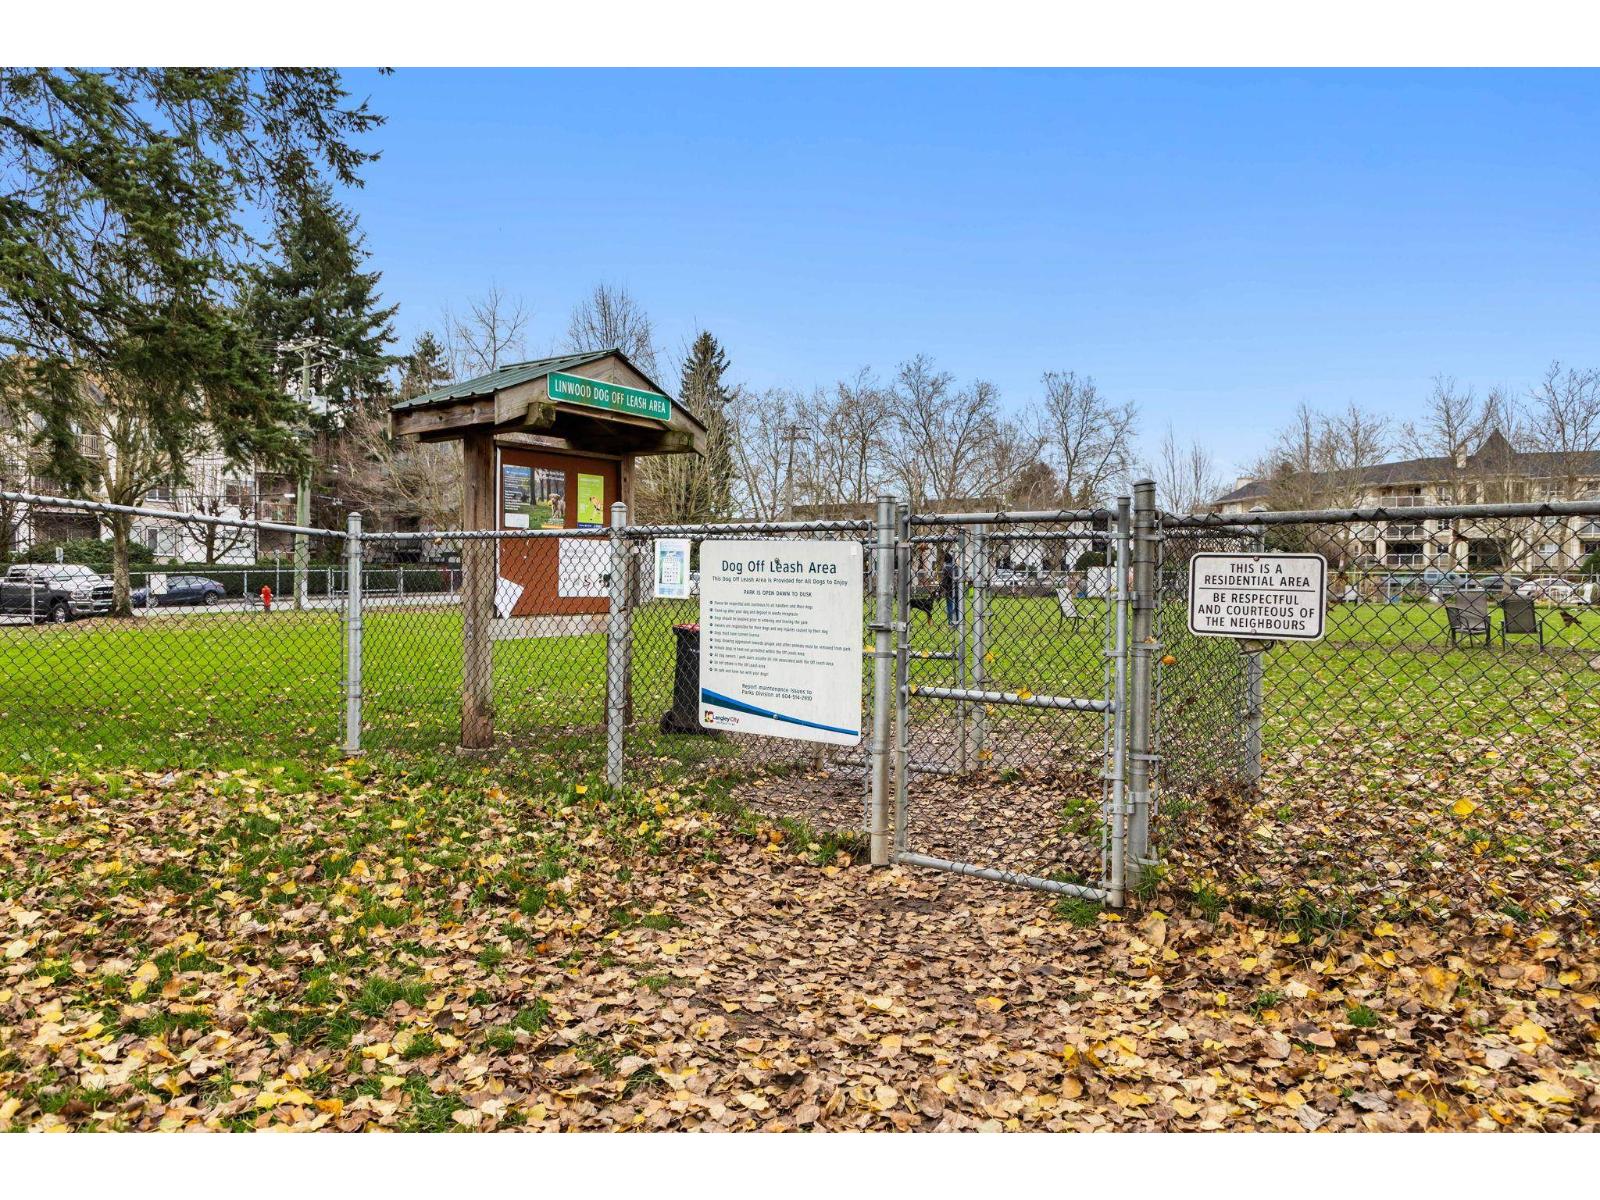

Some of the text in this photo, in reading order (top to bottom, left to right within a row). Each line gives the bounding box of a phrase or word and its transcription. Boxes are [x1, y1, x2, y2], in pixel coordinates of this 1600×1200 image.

[554, 379, 666, 413] LINWOOD DOG OFF LEASH AREA
[722, 560, 837, 575] Dog Off Leash Area
[1230, 563, 1283, 574] THIS IS A
[1204, 575, 1310, 587] RESIDENTIAL AREA
[1213, 593, 1299, 605] BE RESPECTFUL
[1198, 604, 1315, 618] AND COURTEOUS OF
[1206, 617, 1306, 630] THE NEIGHBOURS
